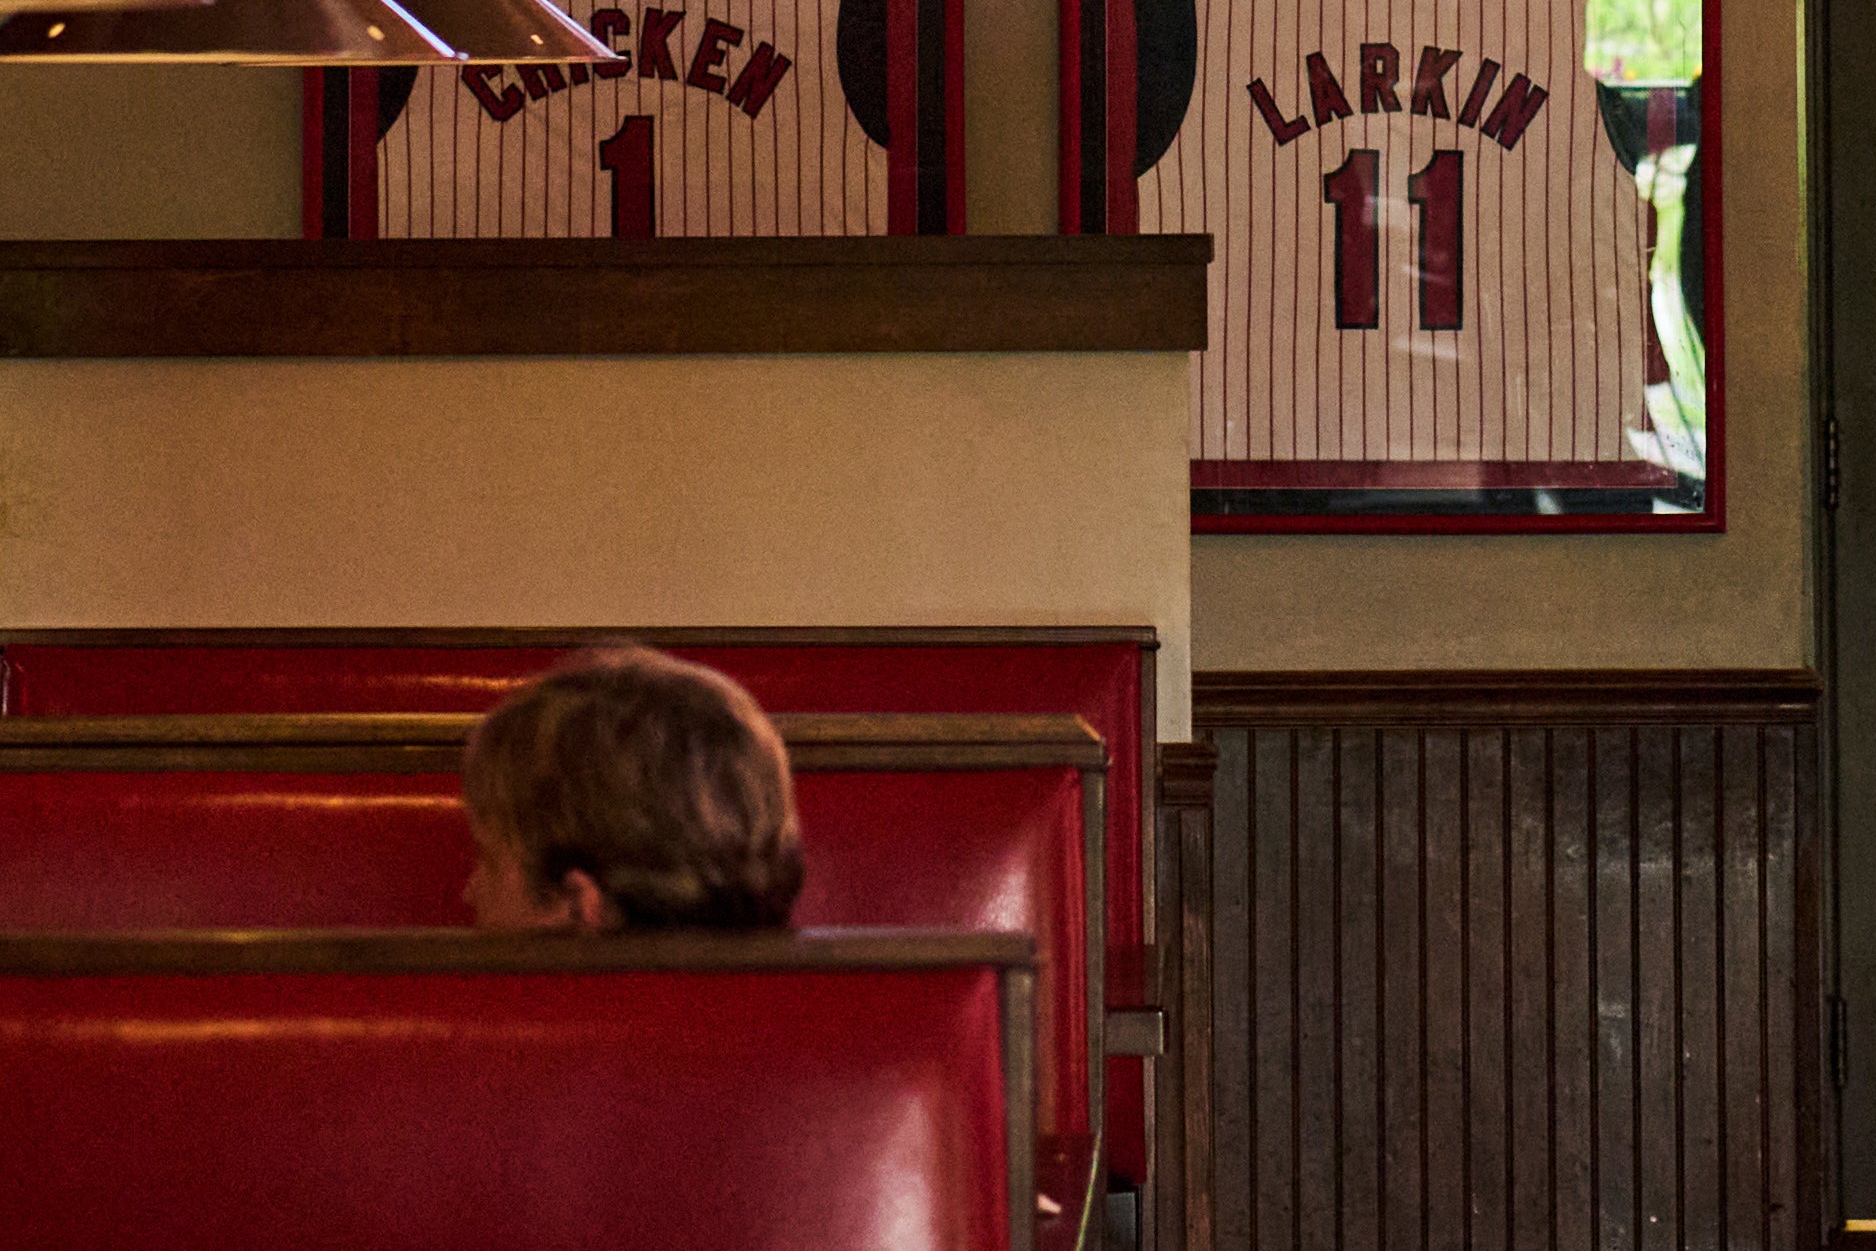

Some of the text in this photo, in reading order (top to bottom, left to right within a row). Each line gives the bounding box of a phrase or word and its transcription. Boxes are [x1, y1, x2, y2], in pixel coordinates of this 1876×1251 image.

[1244, 41, 1549, 152] LARKIN
[599, 115, 655, 237] 1
[1324, 147, 1465, 331] 11
